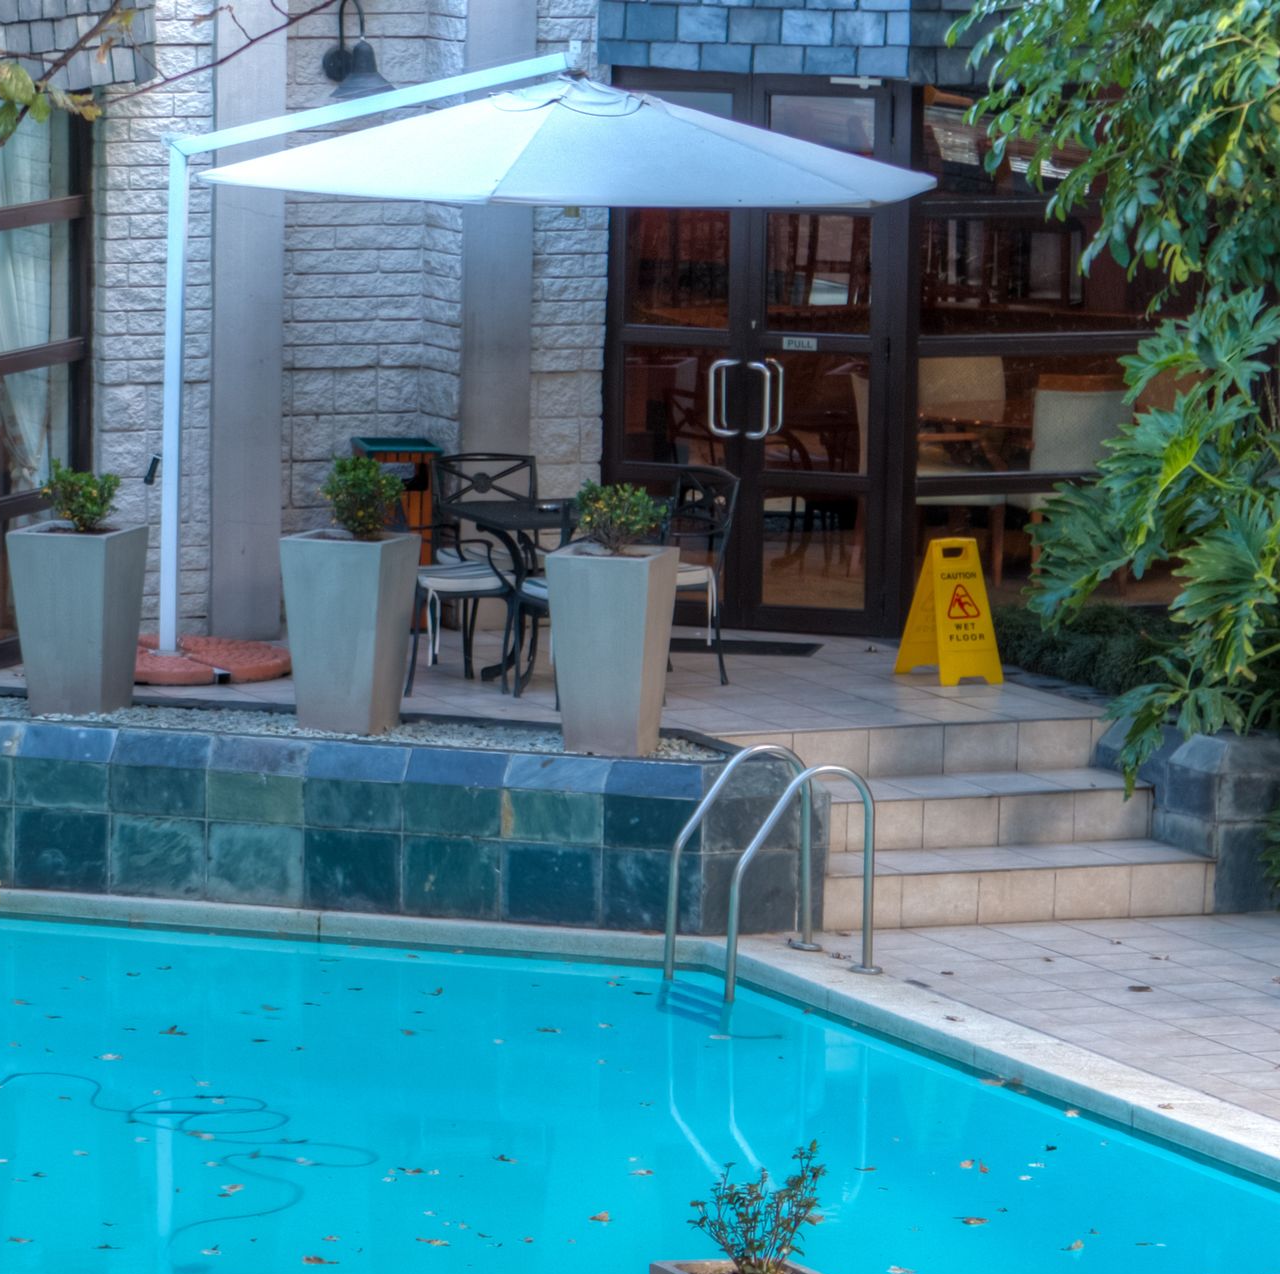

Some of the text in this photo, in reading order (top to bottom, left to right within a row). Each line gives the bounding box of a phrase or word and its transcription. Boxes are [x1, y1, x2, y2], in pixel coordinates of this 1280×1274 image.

[787, 339, 813, 348] PULL
[940, 572, 977, 580] CAUTION
[955, 622, 976, 631] WET
[949, 633, 985, 642] FLOOR
